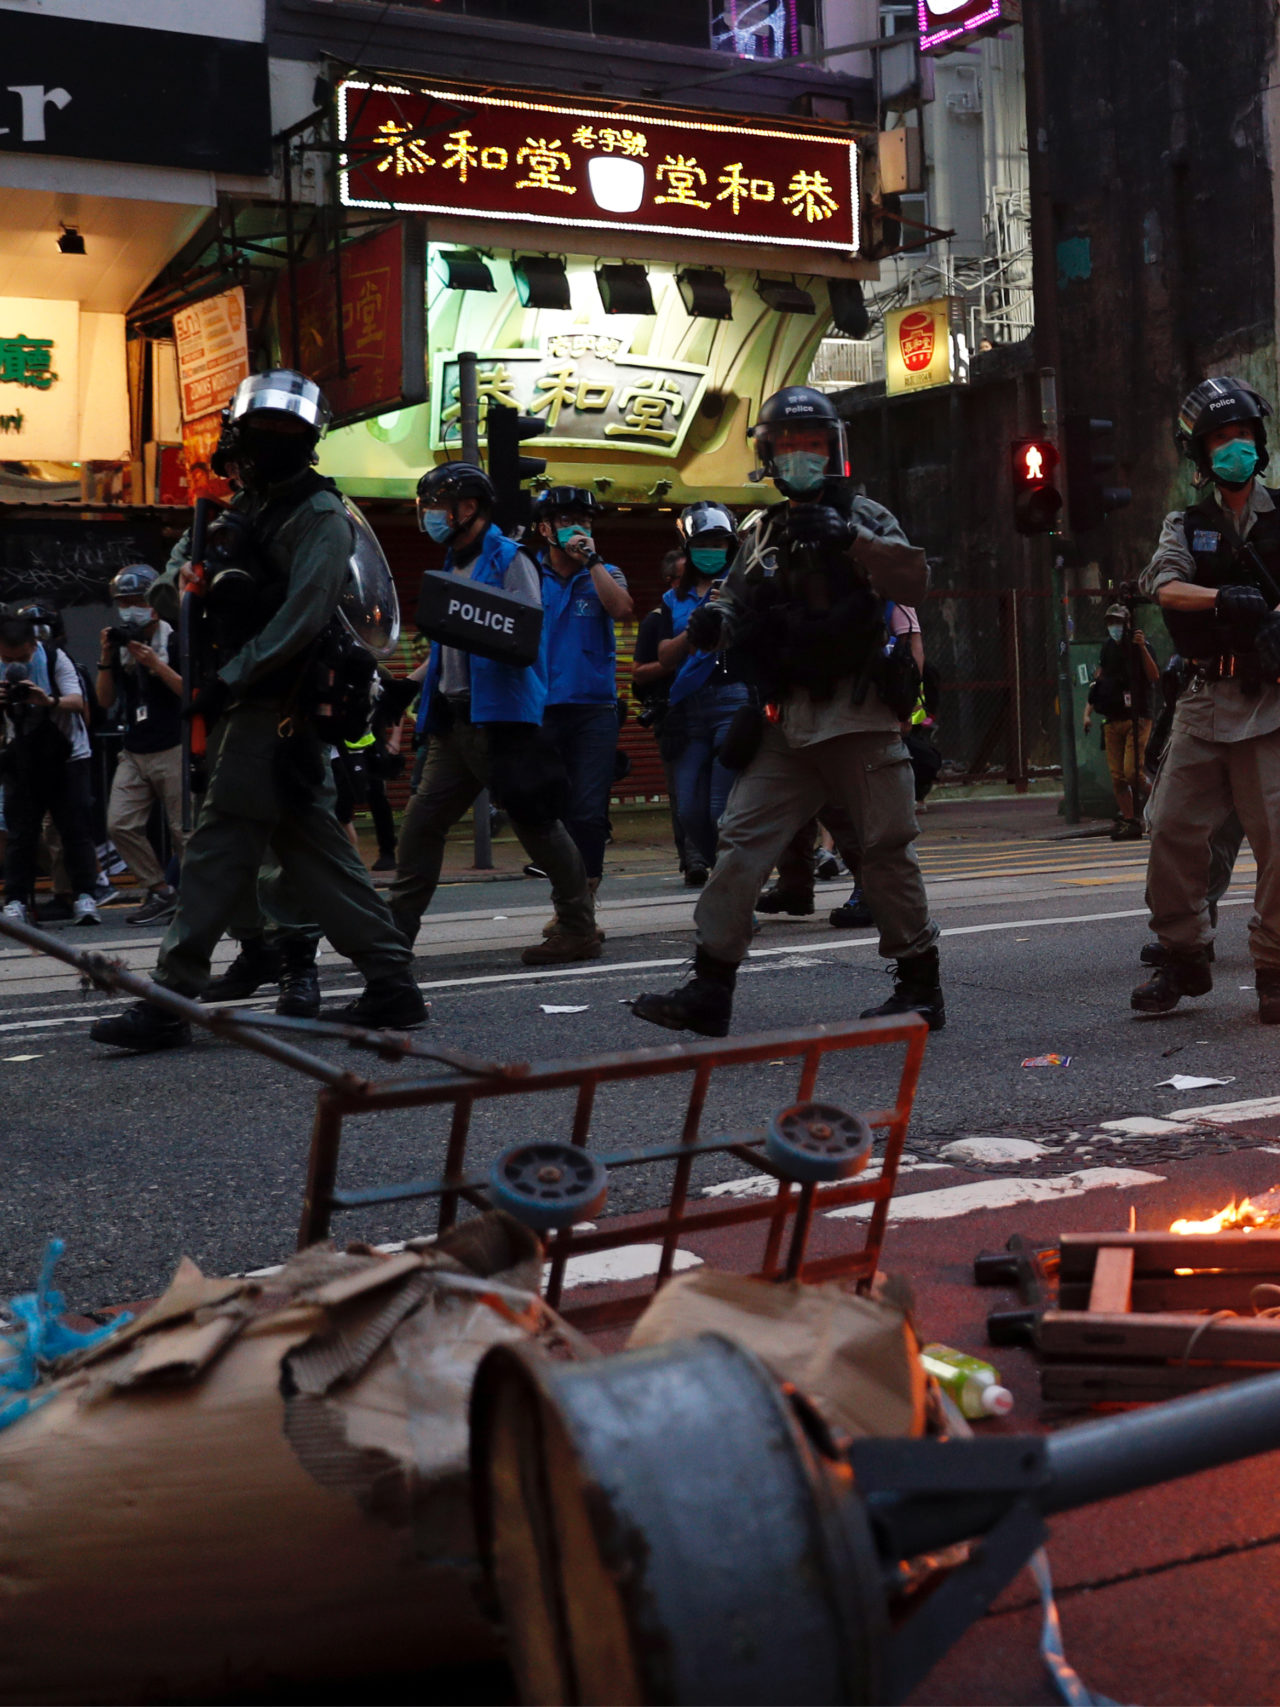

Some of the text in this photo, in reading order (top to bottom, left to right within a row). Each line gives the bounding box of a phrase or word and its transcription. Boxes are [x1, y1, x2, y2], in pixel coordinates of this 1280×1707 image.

[0, 84, 73, 142] r
[784, 405, 814, 415] Police
[1209, 398, 1236, 411] Police
[448, 599, 515, 635] POLICE
